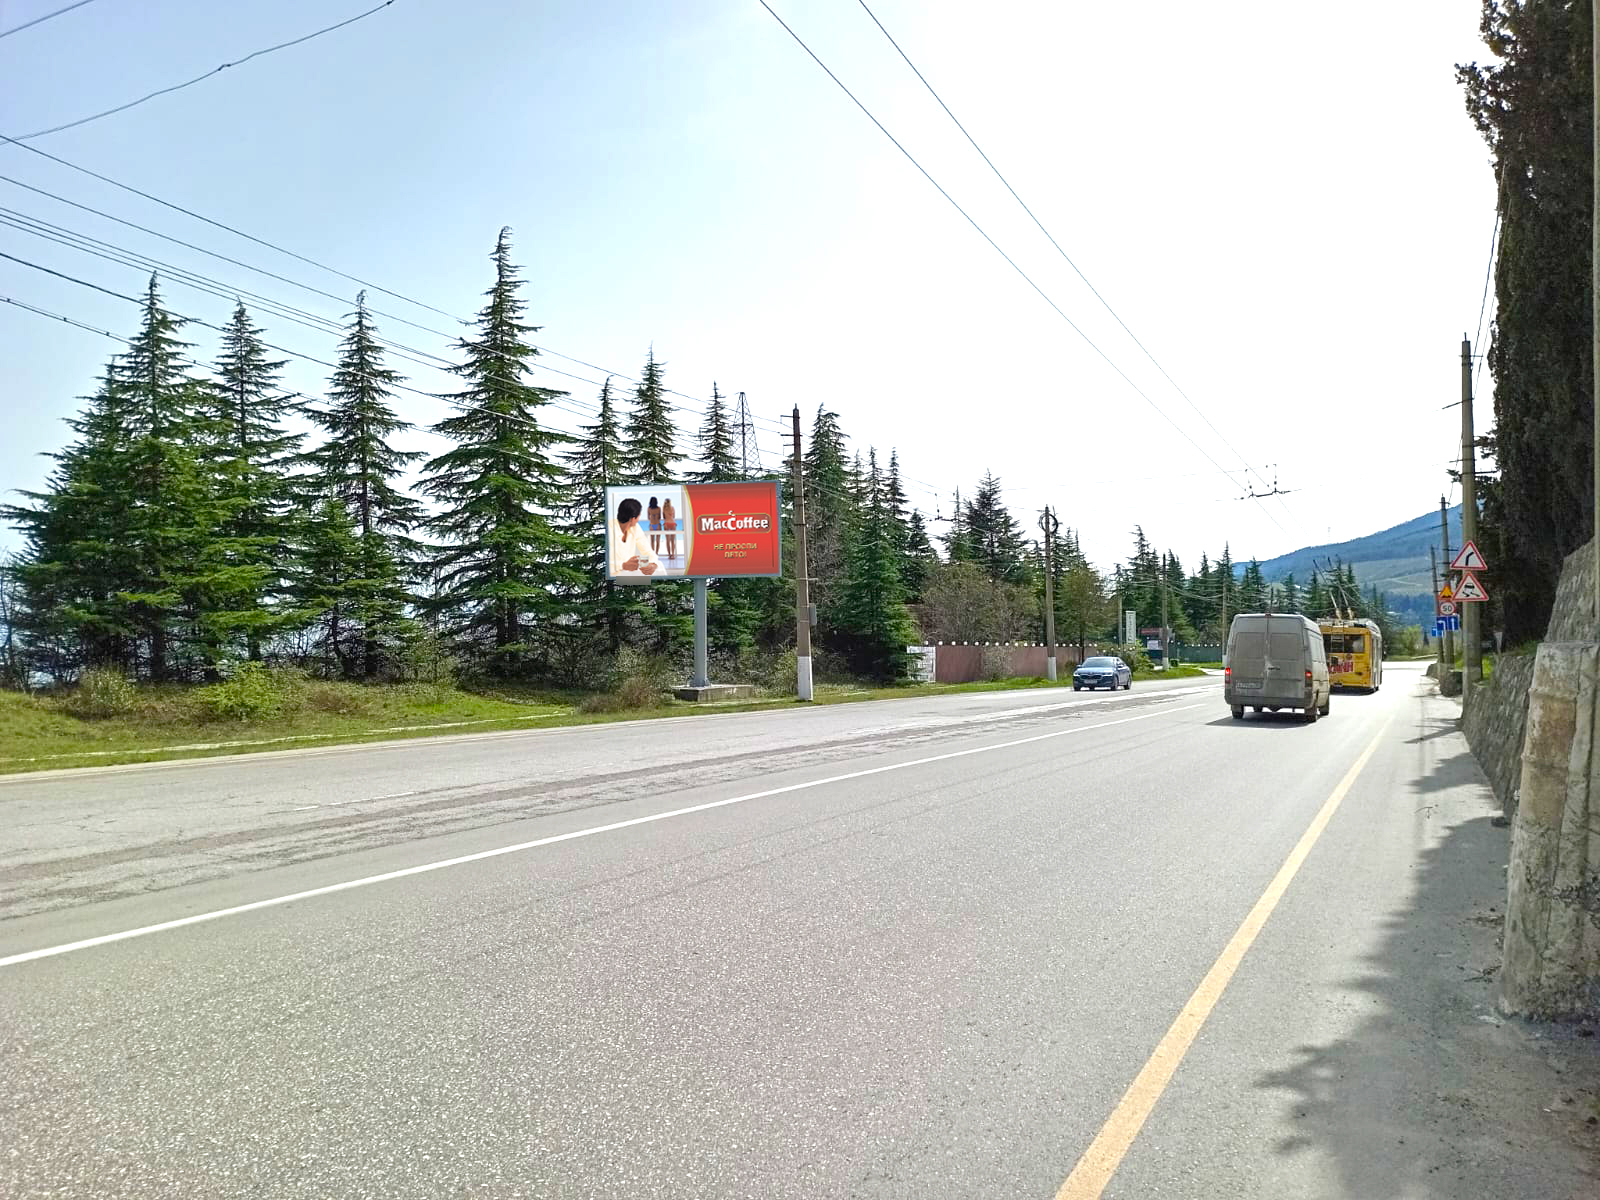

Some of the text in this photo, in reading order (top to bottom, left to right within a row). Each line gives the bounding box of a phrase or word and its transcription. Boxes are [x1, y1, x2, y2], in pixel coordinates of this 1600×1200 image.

[701, 516, 768, 531] MacCoffee
[713, 542, 758, 551] НЕ ПРОСПИ
